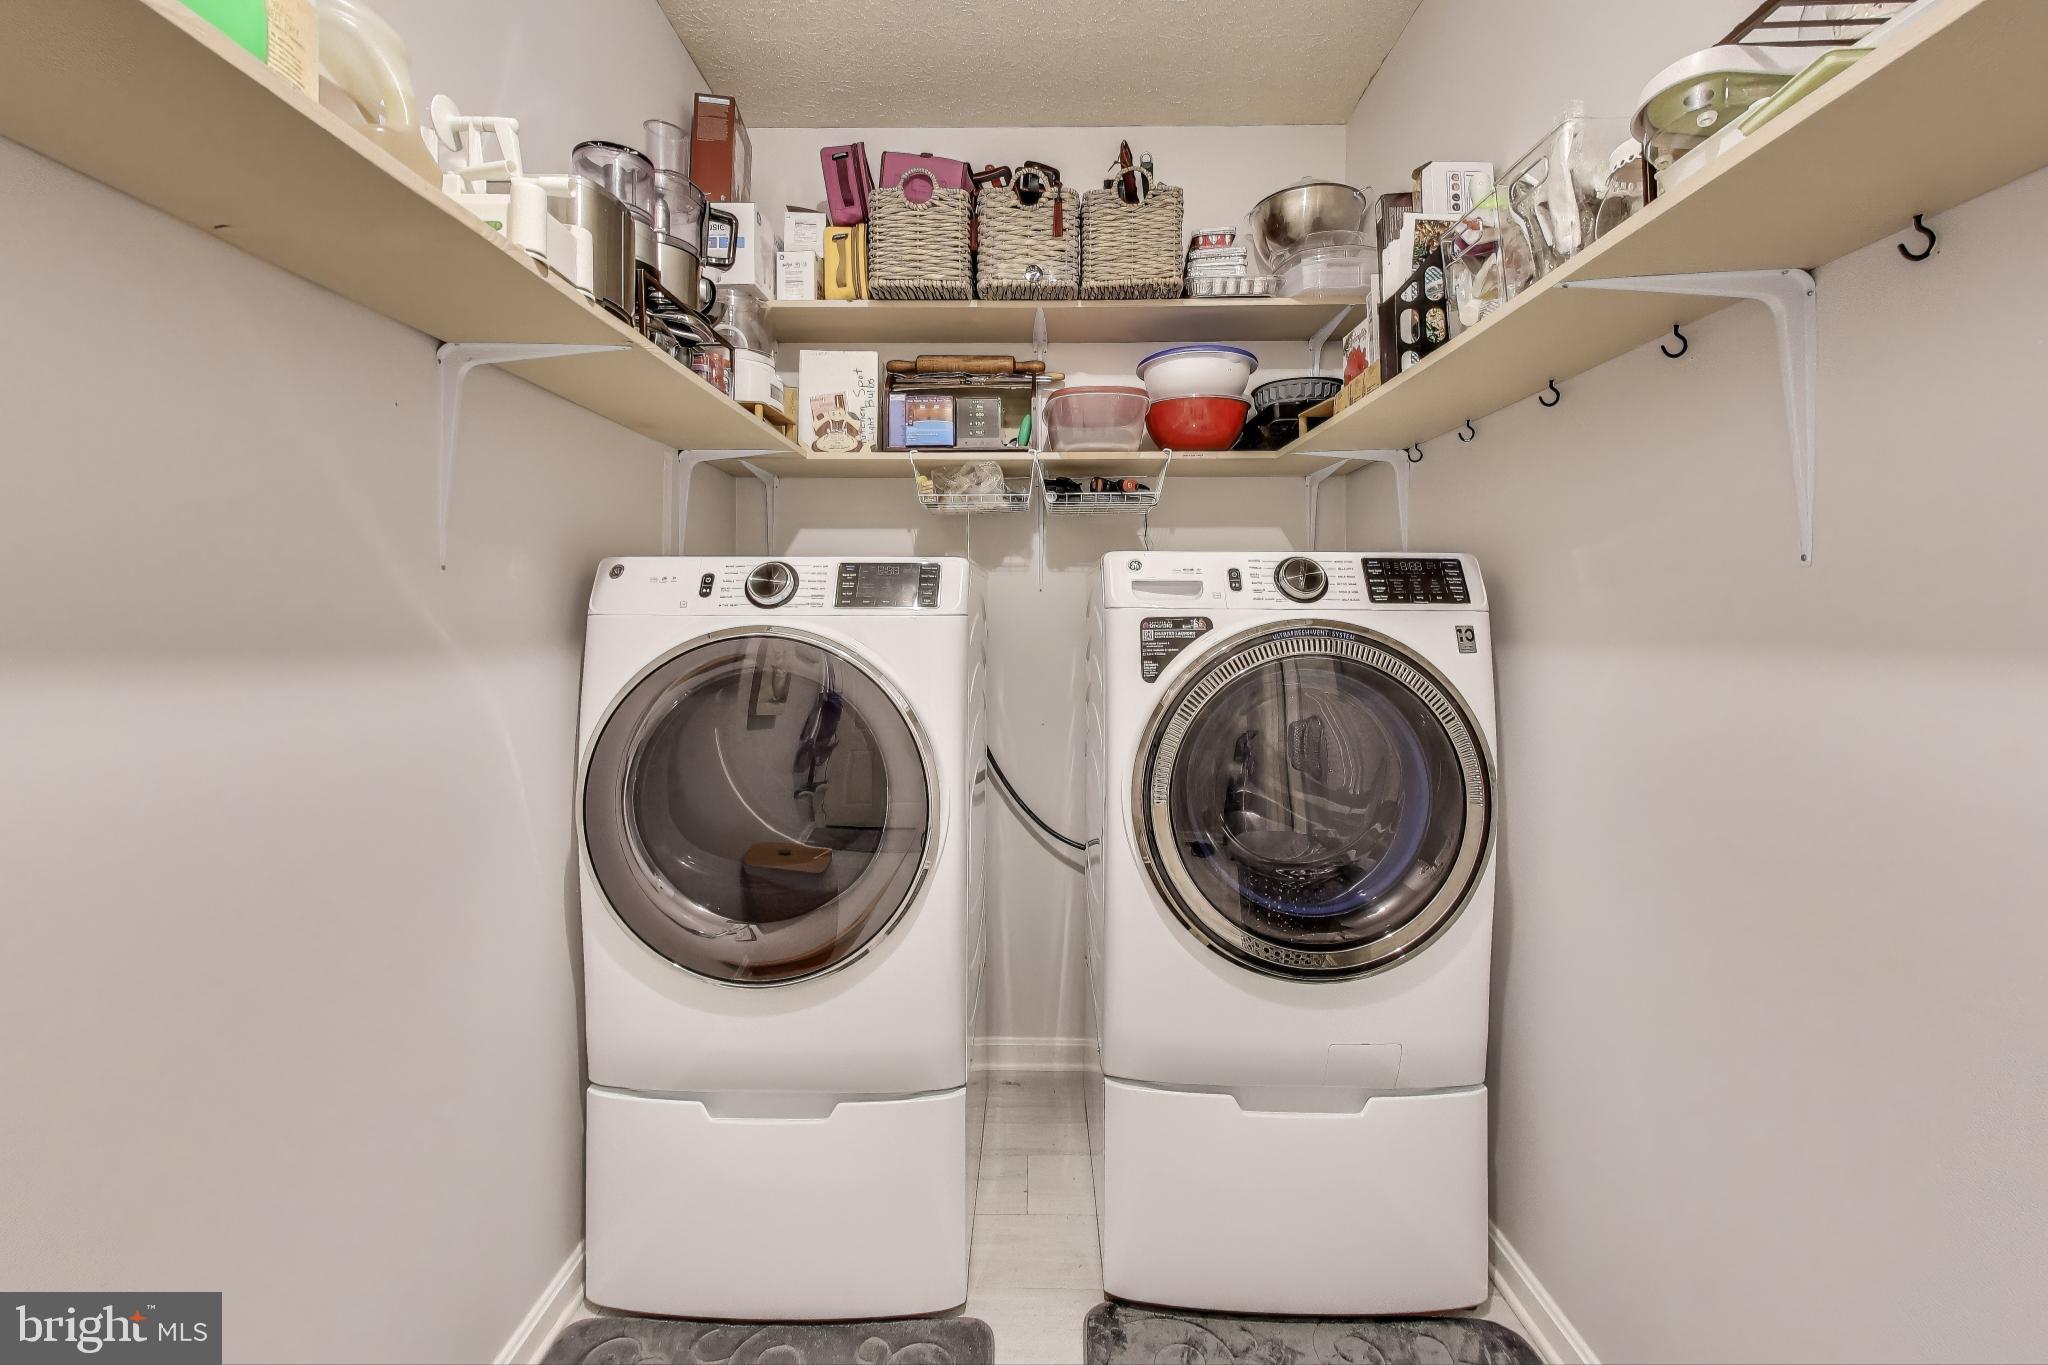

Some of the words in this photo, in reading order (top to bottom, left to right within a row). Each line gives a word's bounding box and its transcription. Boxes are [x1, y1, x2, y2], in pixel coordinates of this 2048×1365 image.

[852, 368, 868, 398] Spot
[864, 378, 877, 408] Bulbs
[1332, 631, 1355, 641] SYSTEM
